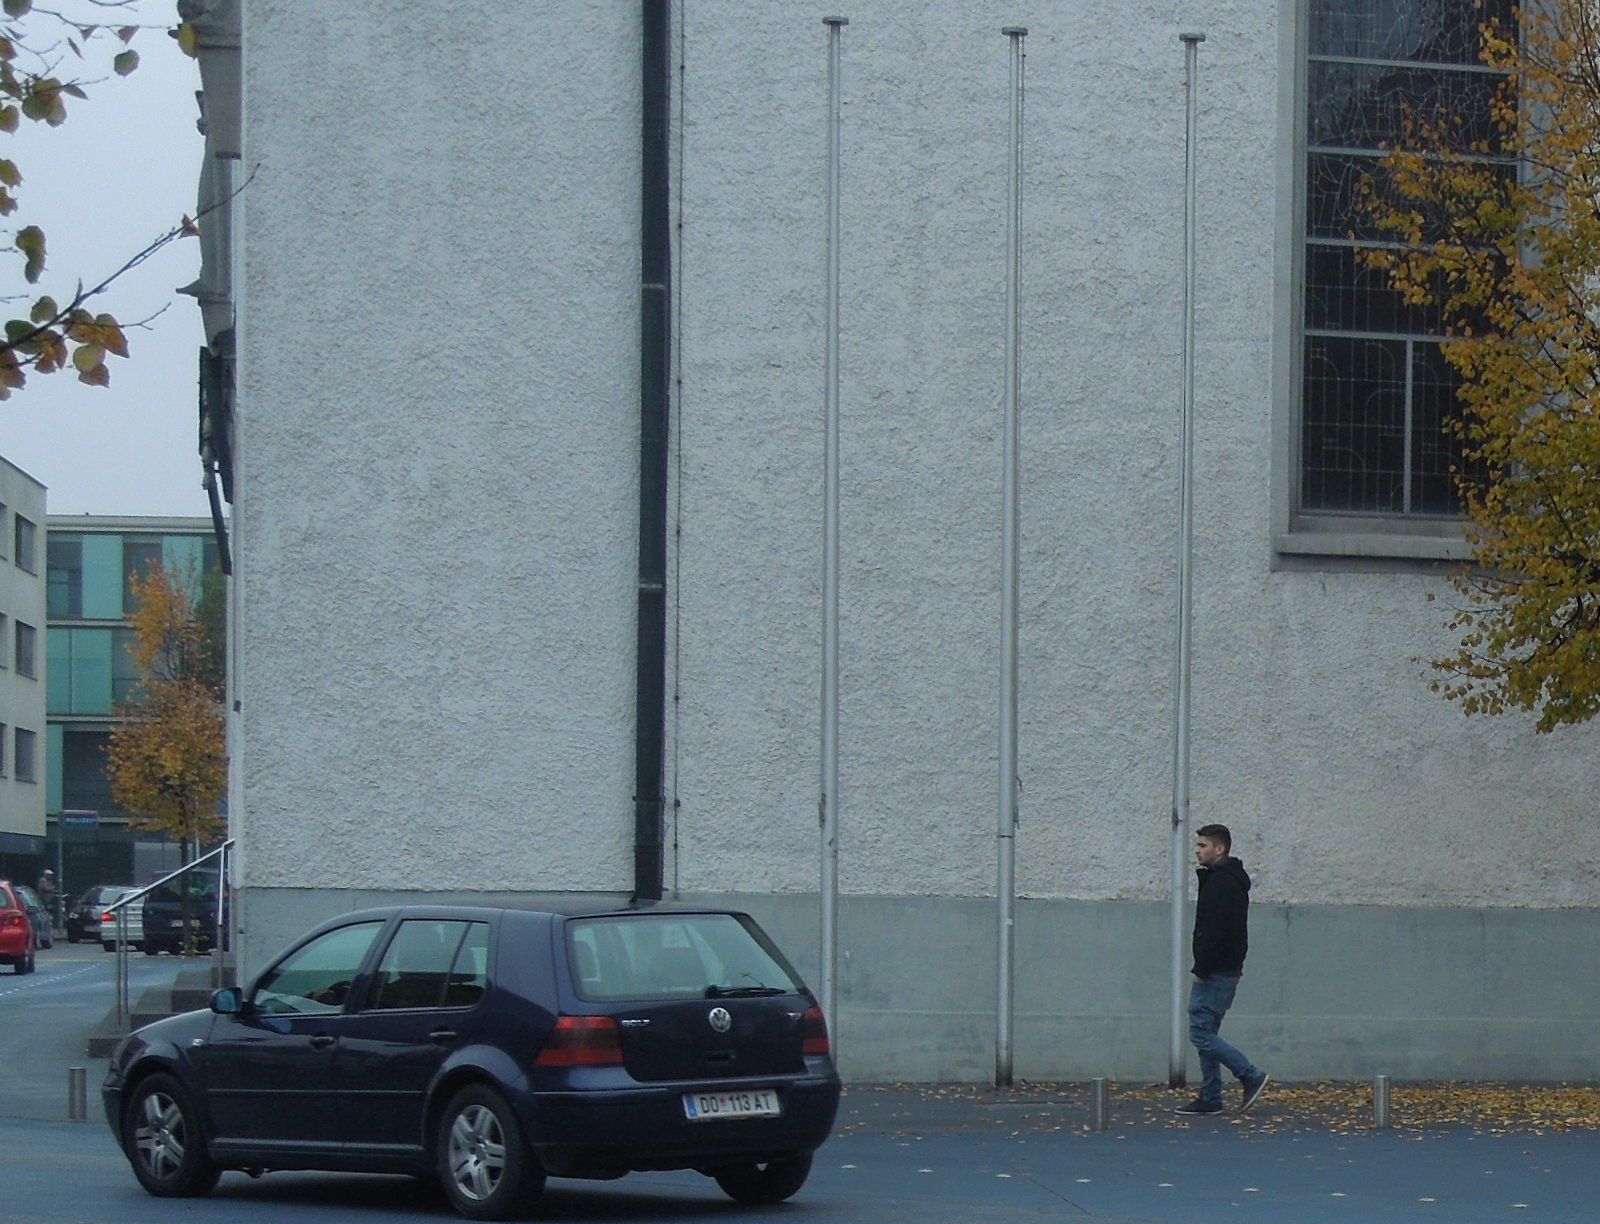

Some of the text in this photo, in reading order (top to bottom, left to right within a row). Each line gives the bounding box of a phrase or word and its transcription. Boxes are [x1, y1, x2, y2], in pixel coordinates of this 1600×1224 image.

[700, 1093, 770, 1114] DO 113 AT
